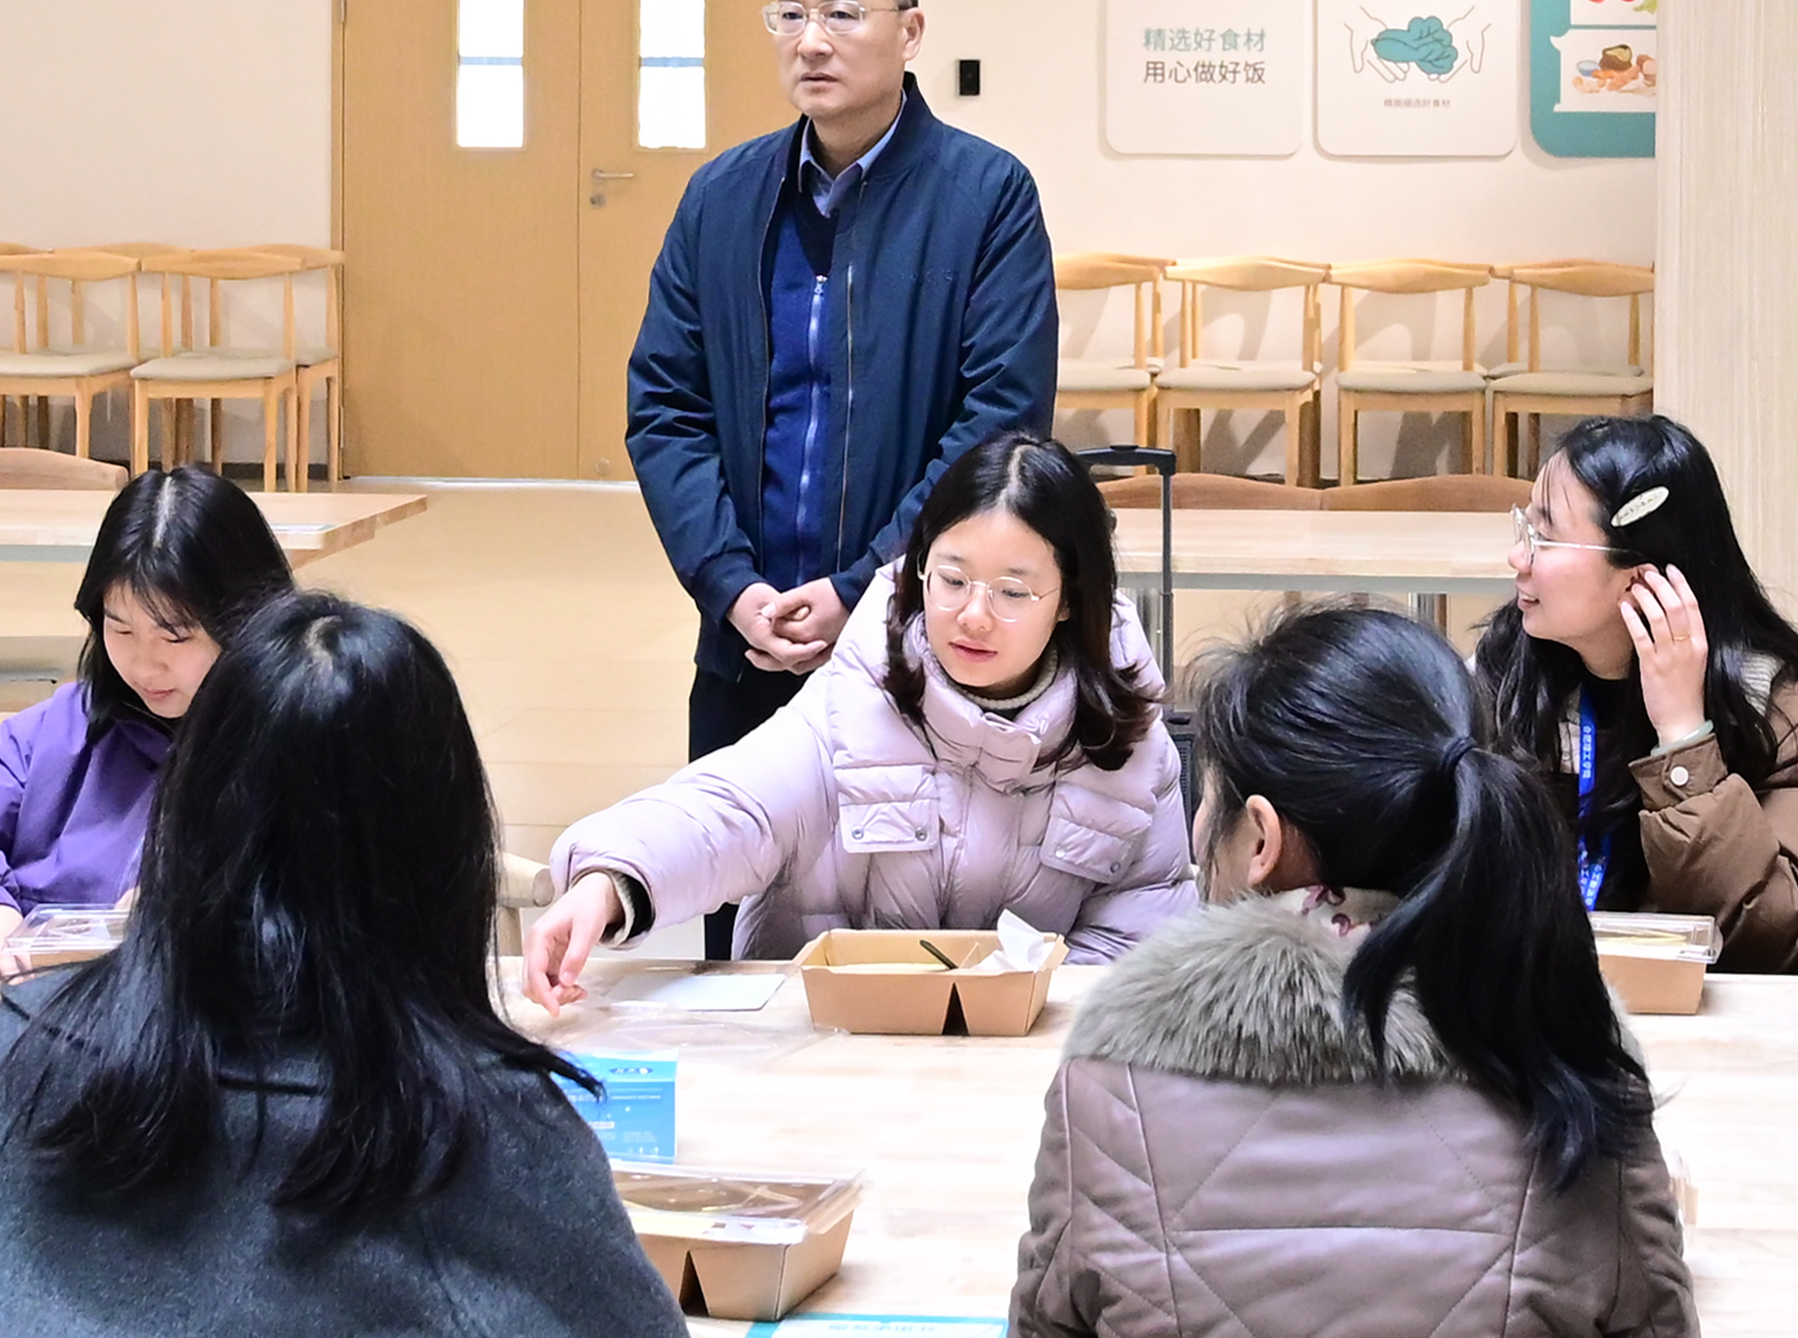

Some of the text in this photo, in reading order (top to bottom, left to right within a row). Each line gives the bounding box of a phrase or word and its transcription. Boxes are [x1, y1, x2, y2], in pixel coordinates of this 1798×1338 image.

[1143, 28, 1265, 52] 精选好食材
[1143, 60, 1265, 84] 用心做好饭
